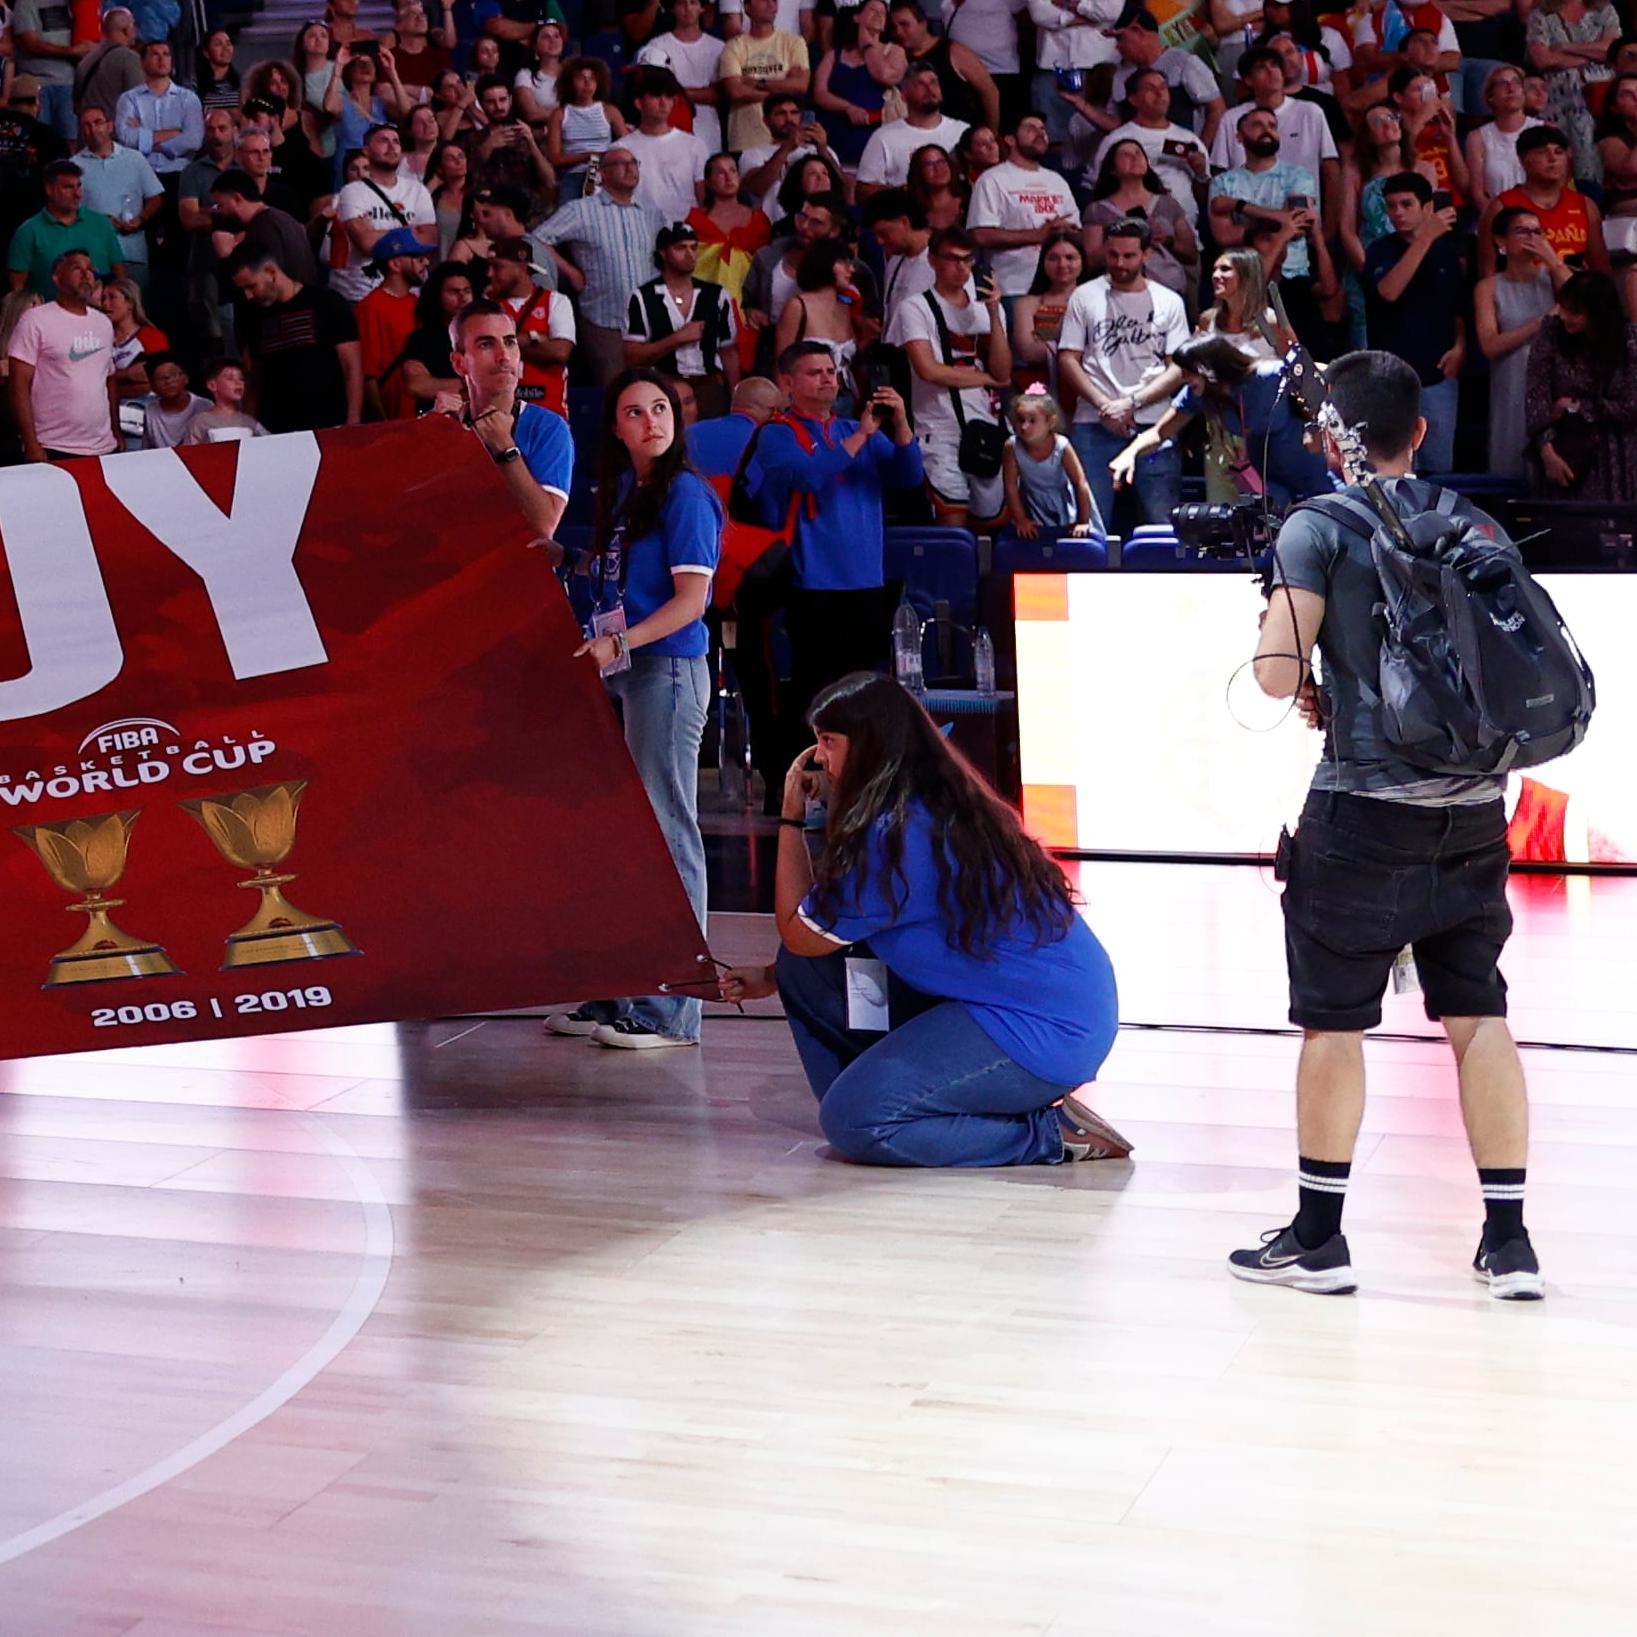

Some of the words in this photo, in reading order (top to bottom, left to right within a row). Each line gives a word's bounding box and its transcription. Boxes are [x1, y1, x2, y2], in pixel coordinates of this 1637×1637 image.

[98, 727, 159, 753] FIBA
[182, 740, 276, 775] CUP
[91, 1001, 197, 1027] 2006
[235, 986, 332, 1013] 2019
